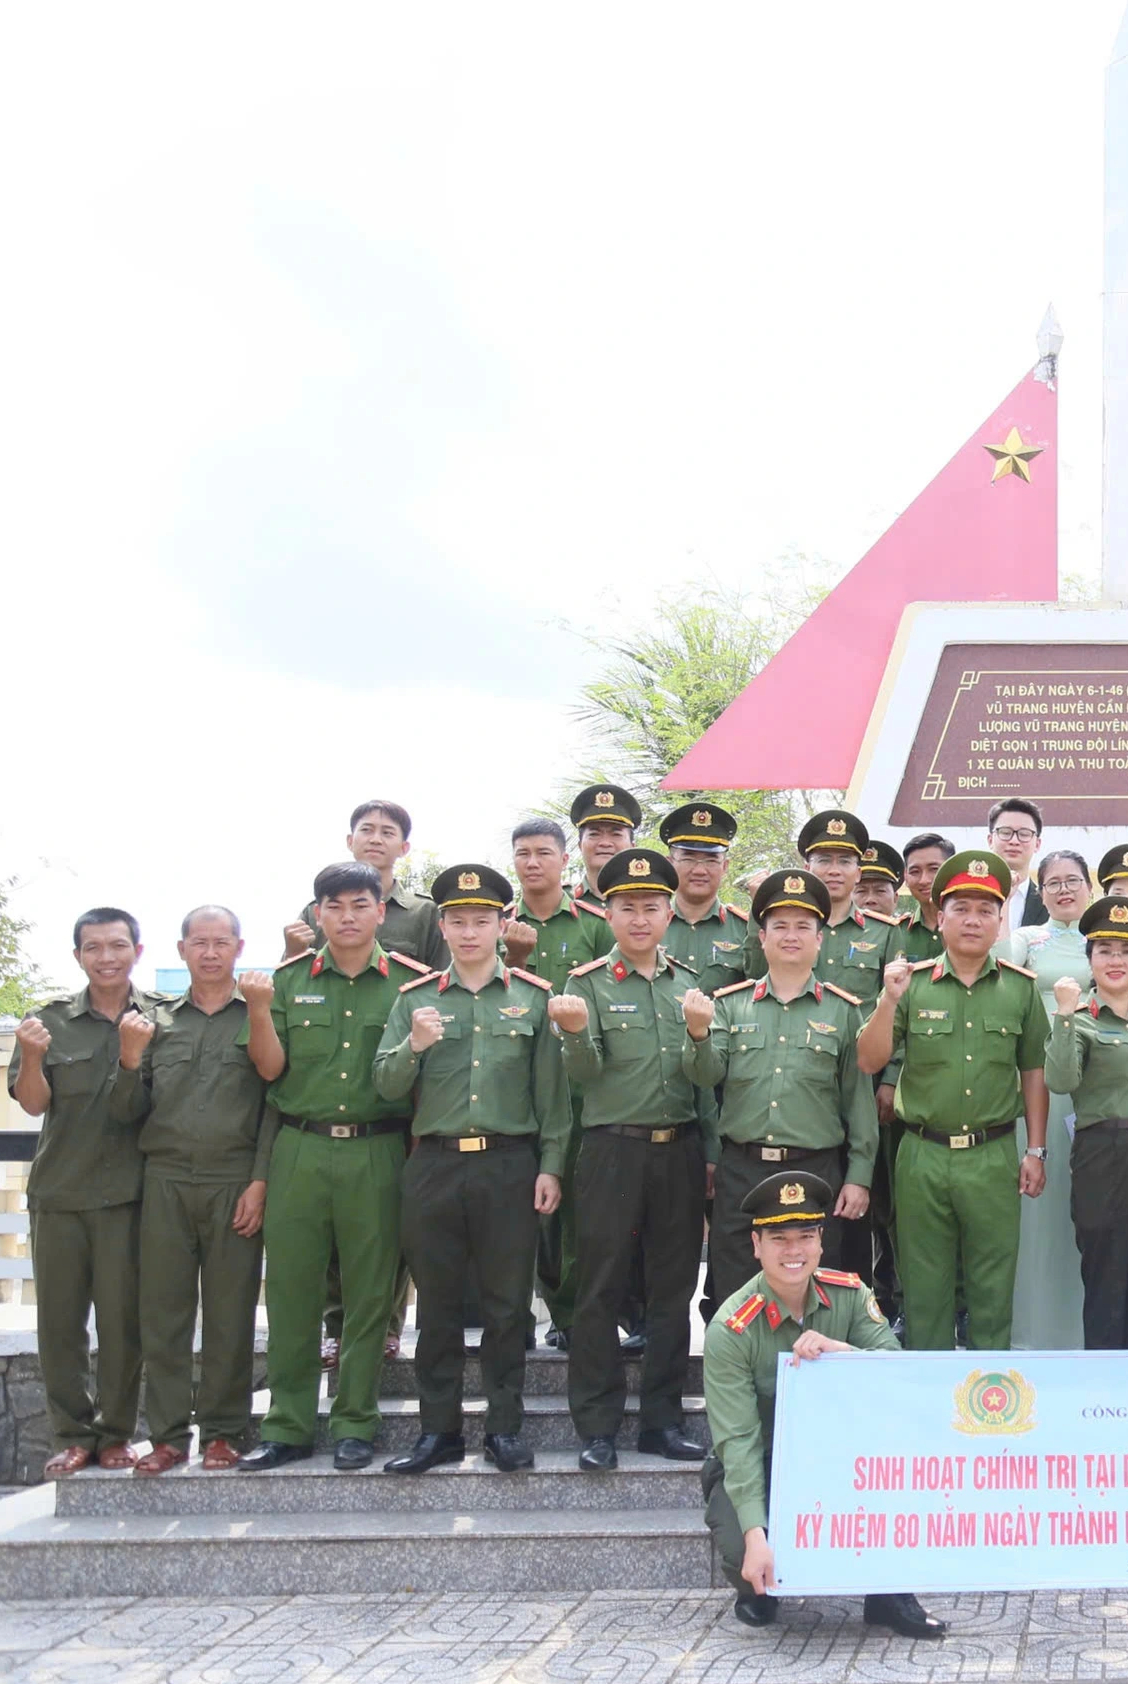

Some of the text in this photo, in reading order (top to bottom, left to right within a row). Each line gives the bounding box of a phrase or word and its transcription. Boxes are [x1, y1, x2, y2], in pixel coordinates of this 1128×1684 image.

[995, 686, 1015, 698] TẠI
[1019, 683, 1044, 696] ĐÂY
[1049, 683, 1084, 696] NGÀY
[1087, 685, 1123, 695] 6-1-46
[986, 701, 1002, 714] VŨ
[1006, 703, 1048, 714] TRANG
[1052, 700, 1093, 716] HUYỆN
[979, 720, 1020, 734] LƯỢNG
[1024, 719, 1040, 732] VŨ
[1043, 721, 1084, 732] TRANG
[1088, 718, 1128, 733] HUYỆN
[971, 738, 998, 753] DIỆT
[1002, 740, 1028, 753] GỌN
[1041, 740, 1083, 751] TRUNG
[1087, 737, 1107, 752] ĐỘI
[978, 759, 994, 769] XE
[998, 756, 1033, 769] QUÂN
[1037, 757, 1055, 771] SỰ
[1059, 756, 1075, 769] VÀ
[1079, 758, 1104, 769] THU
[958, 777, 986, 789] ĐỊCH
[1081, 1403, 1127, 1418] CÔNG
[854, 1456, 905, 1491] SINH
[912, 1456, 967, 1498] HOẠT
[973, 1448, 1038, 1490] CHÍNH
[1044, 1454, 1077, 1496] TRỊ
[1084, 1454, 1116, 1496] TẠI
[796, 1501, 823, 1548] KỶ
[830, 1506, 887, 1556] NIỆM
[894, 1514, 920, 1548] 80
[927, 1507, 977, 1547] NĂM
[984, 1505, 1041, 1546] NGÀY
[1048, 1505, 1118, 1545] THÀNH
